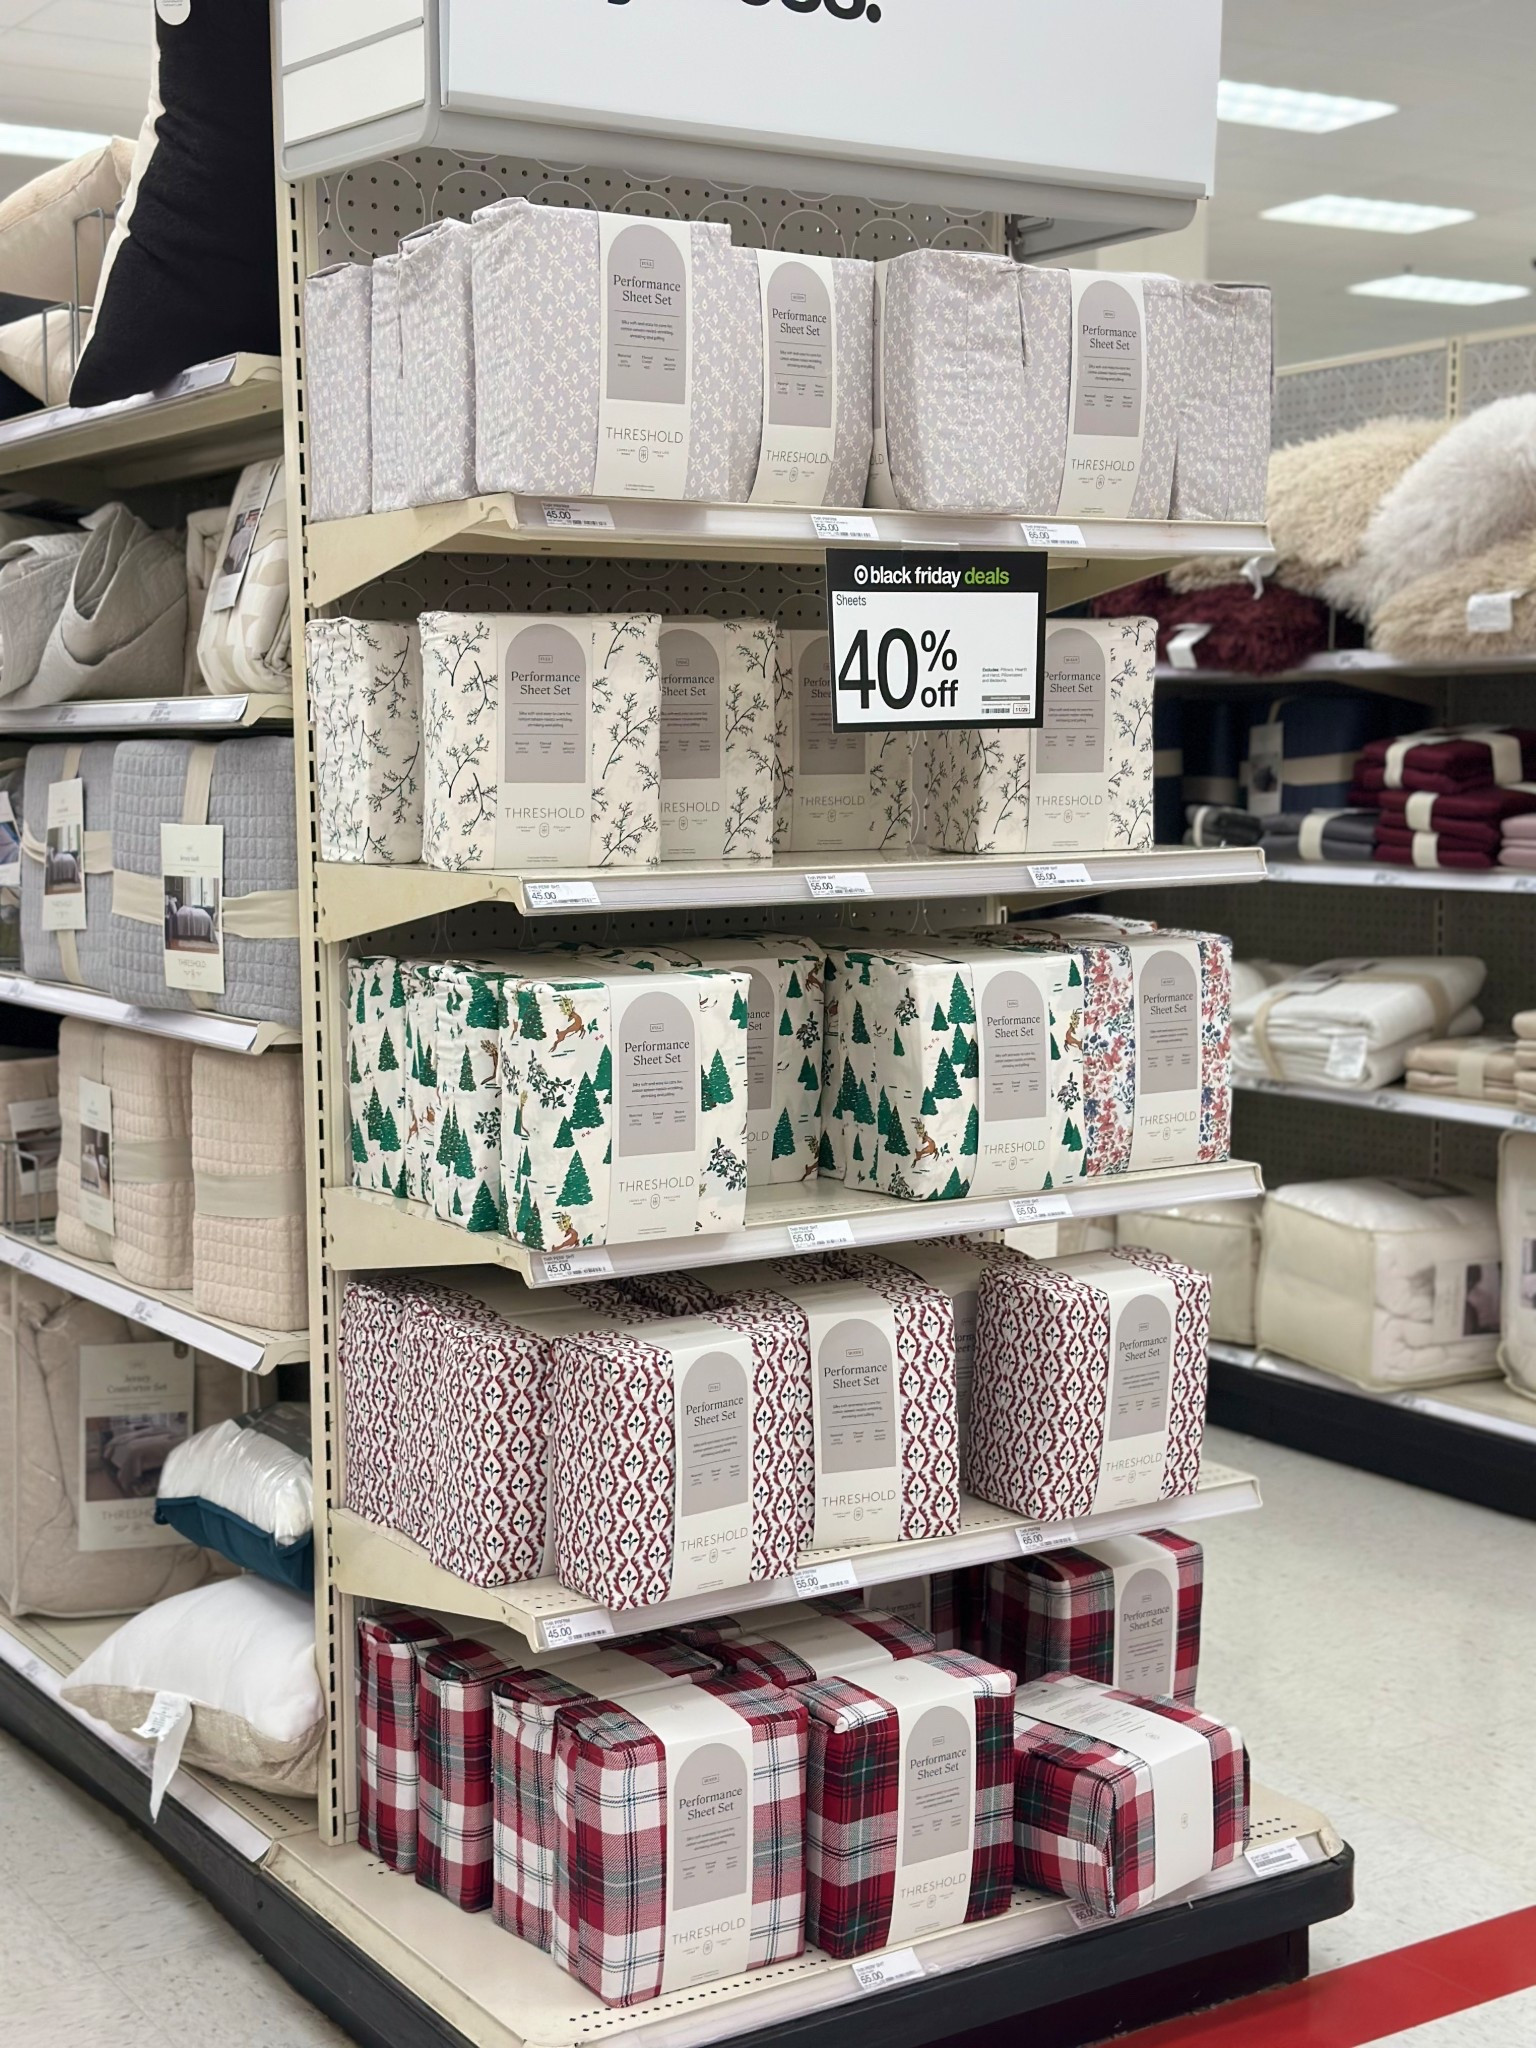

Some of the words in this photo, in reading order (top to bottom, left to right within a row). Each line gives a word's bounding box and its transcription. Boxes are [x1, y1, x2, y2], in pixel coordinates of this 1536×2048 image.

[613, 274, 681, 292] Performance
[622, 290, 652, 304] Sheet
[655, 294, 672, 306] Set
[772, 308, 827, 323] Performance
[780, 322, 804, 335] Sheet
[806, 325, 820, 336] Set
[1082, 324, 1137, 338] Performance
[1089, 337, 1114, 350] Sheet
[1116, 340, 1130, 351] Set
[606, 426, 684, 444] THRESHOLD
[766, 449, 829, 464] THRESHOLD
[1071, 458, 1135, 472] THRESHOLD
[546, 511, 571, 520] 45.00
[816, 523, 839, 532] 55.00
[1028, 531, 1050, 540] 65.00
[871, 565, 912, 585] black
[914, 566, 961, 588] friday
[964, 567, 1010, 585] deals
[836, 594, 867, 606] Sheets
[511, 670, 581, 683] Performance
[520, 684, 551, 695] Sheet
[553, 685, 570, 695] Set
[690, 686, 706, 697] Set
[920, 679, 959, 708] off
[1050, 683, 1077, 693] Sheet
[1078, 683, 1094, 693] Set
[799, 795, 865, 807] THRESHOLD
[1036, 795, 1103, 806] THRESHOLD
[504, 807, 585, 819] THRESHOLD
[1035, 873, 1057, 881] 65.00
[810, 882, 834, 891] 55.00
[531, 892, 557, 900] 45.00
[1143, 992, 1194, 1005] Performance
[1150, 1005, 1173, 1015] Sheet
[1174, 1003, 1187, 1013] Set
[748, 1021, 763, 1031] Set
[986, 1015, 1041, 1026] Performance
[994, 1028, 1019, 1038] Sheet
[1020, 1027, 1035, 1037] Set
[624, 1040, 690, 1053] Performance
[633, 1055, 662, 1066] Sheet
[664, 1053, 682, 1064] Set
[1139, 1110, 1197, 1126] THRESHOLD
[984, 1140, 1046, 1155] THRESHOLD
[619, 1175, 695, 1192] THRESHOLD
[1016, 1206, 1037, 1216] 65.00
[792, 1232, 816, 1243] 55.00
[546, 1262, 571, 1273] 45.00
[1119, 1336, 1168, 1351] Performance
[1124, 1350, 1146, 1362] Sheet
[1147, 1348, 1161, 1358] Set
[823, 1364, 888, 1378] Performance
[832, 1377, 861, 1389] Sheet
[863, 1375, 880, 1386] Set
[685, 1396, 744, 1416] Performance
[693, 1413, 721, 1427] Sheet
[721, 1410, 737, 1422] Set
[1105, 1452, 1163, 1472] THRESHOLD
[822, 1489, 896, 1508] THRESHOLD
[680, 1526, 748, 1552] THRESHOLD
[1022, 1533, 1043, 1545] 65.00
[795, 1576, 819, 1588] 55.00
[1122, 1604, 1170, 1623] Performance
[1128, 1619, 1151, 1632] Sheet
[1150, 1616, 1164, 1628] Set
[547, 1625, 572, 1639] 45.00
[910, 1748, 967, 1770] Performance
[917, 1767, 943, 1780] Sheet
[944, 1762, 960, 1774] Set
[679, 1787, 743, 1810] Performance
[687, 1807, 716, 1821] Sheet
[717, 1801, 734, 1814] Set
[899, 1872, 967, 1899] THRESHOLD
[672, 1917, 746, 1945] THRESHOLD
[860, 1970, 884, 1985] 55.00
